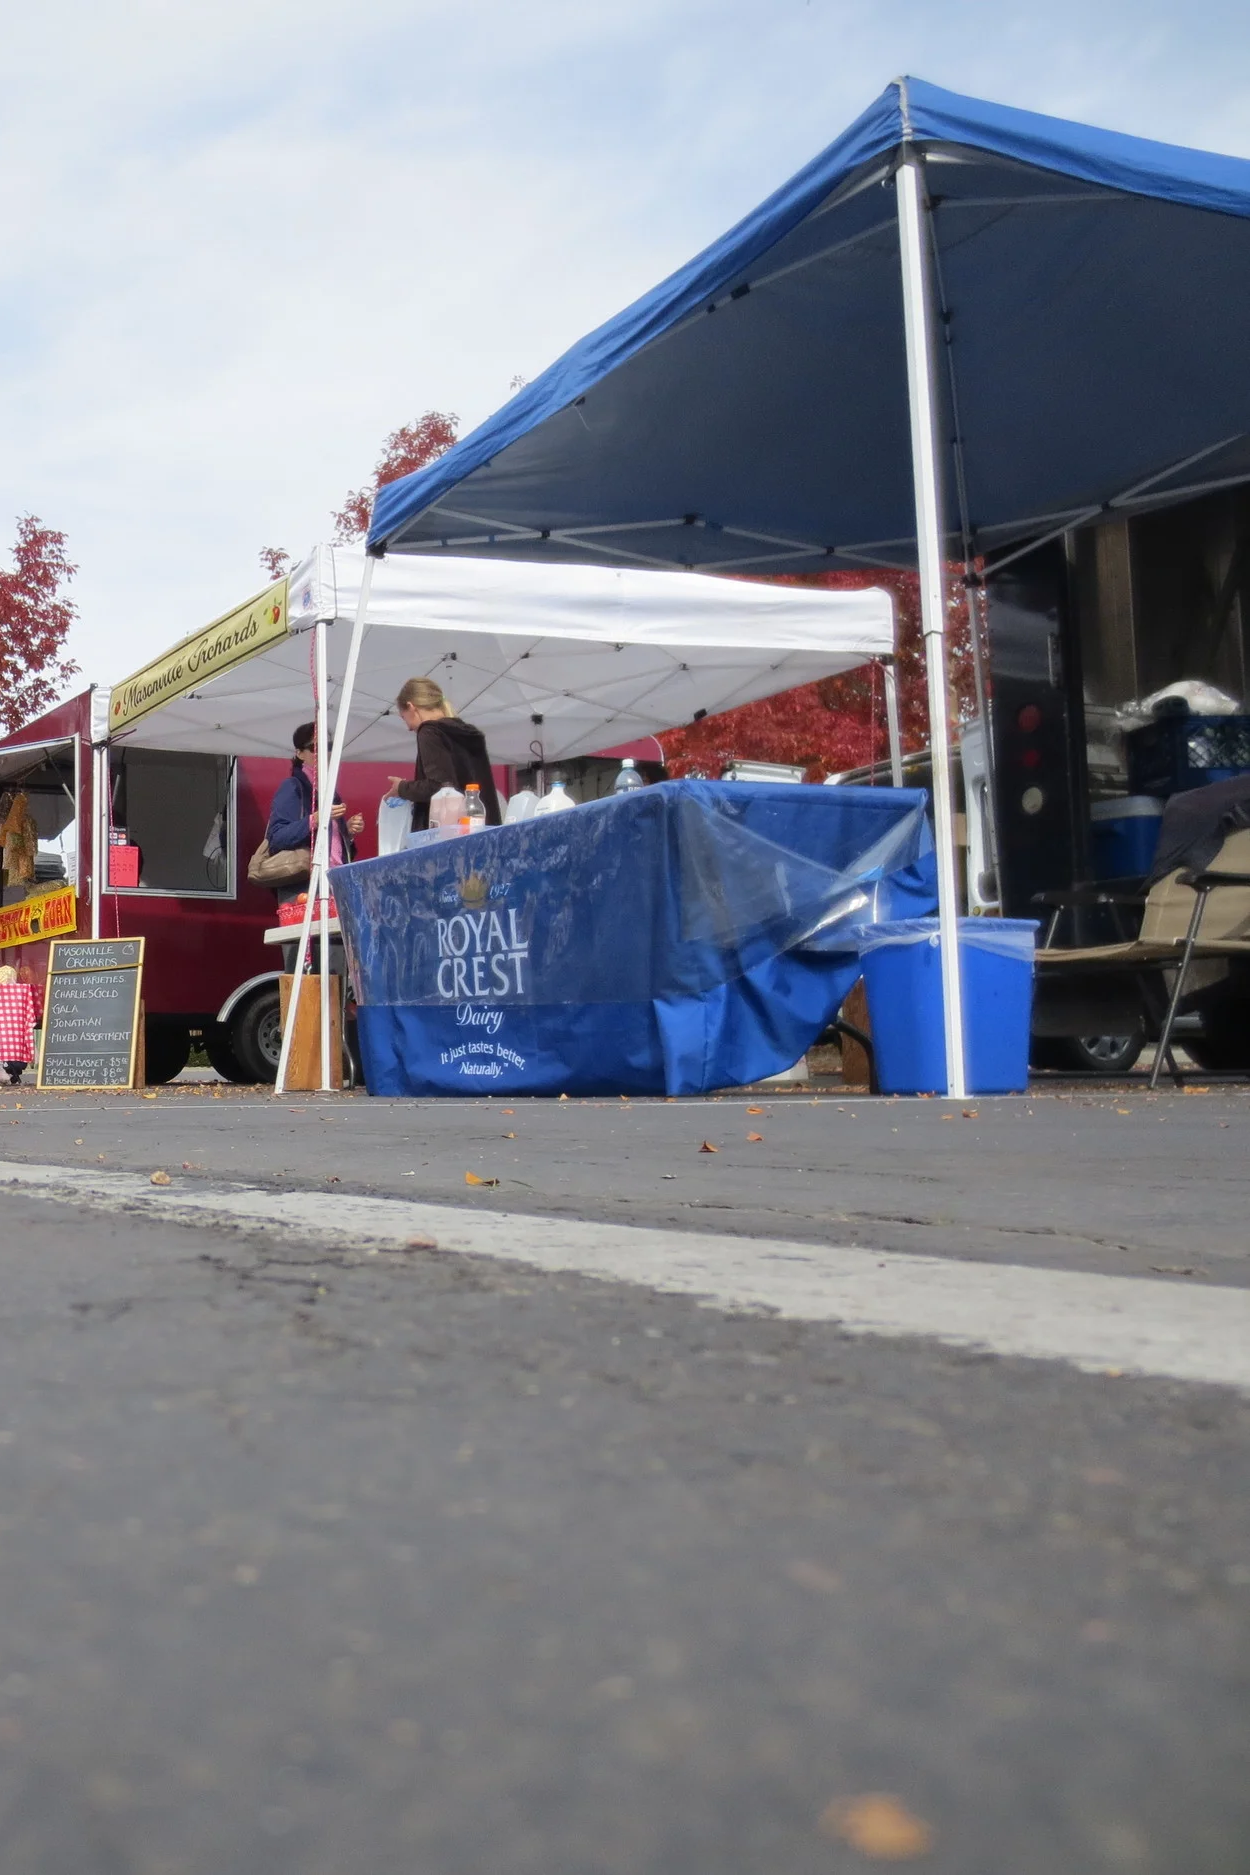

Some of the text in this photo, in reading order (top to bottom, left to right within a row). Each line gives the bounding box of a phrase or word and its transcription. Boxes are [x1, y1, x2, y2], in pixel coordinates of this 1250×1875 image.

[122, 613, 259, 716] Masonville Orchards
[490, 882, 511, 900] 1927
[43, 891, 72, 931] CORN
[437, 908, 529, 957] ROYAL
[58, 946, 115, 956] MASONVILLE
[65, 957, 118, 968] ORCHARDS
[53, 976, 79, 985] APPLE
[437, 951, 528, 998] CREST
[456, 1001, 504, 1034] Dairy
[79, 1031, 131, 1042] ASSORTMENT
[46, 1057, 74, 1068] SMALL
[75, 1057, 105, 1068] BASKET
[440, 1041, 526, 1070] It just tastes better.
[68, 1068, 97, 1078] BASKET
